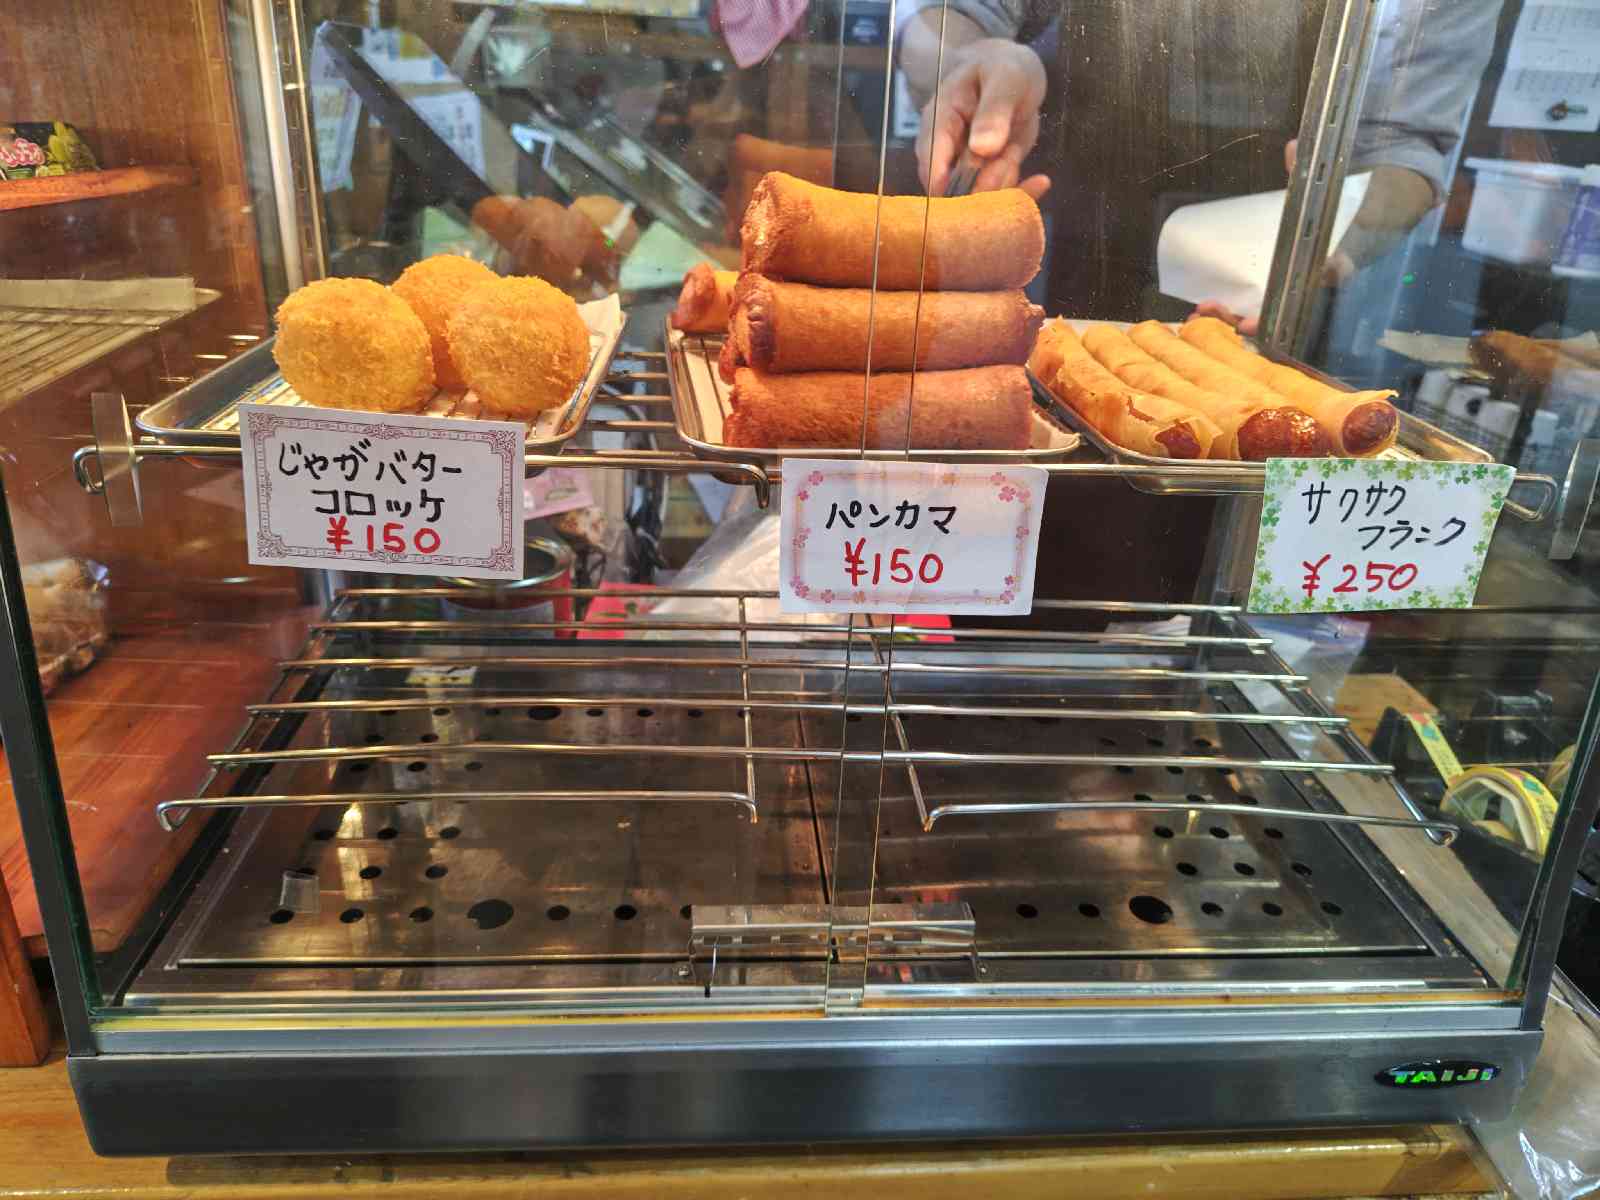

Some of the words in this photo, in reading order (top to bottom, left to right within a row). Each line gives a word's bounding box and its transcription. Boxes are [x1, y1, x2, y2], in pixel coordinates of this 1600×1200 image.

[279, 440, 462, 484] じゃがバター
[311, 489, 445, 522] コロッケ
[825, 500, 957, 534] パンカマ
[1302, 481, 1406, 524] サクサク
[326, 516, 441, 556] ¥150
[845, 537, 944, 586] ¥150
[1302, 554, 1418, 598] ¥250
[1389, 1067, 1495, 1084] TAIJI
